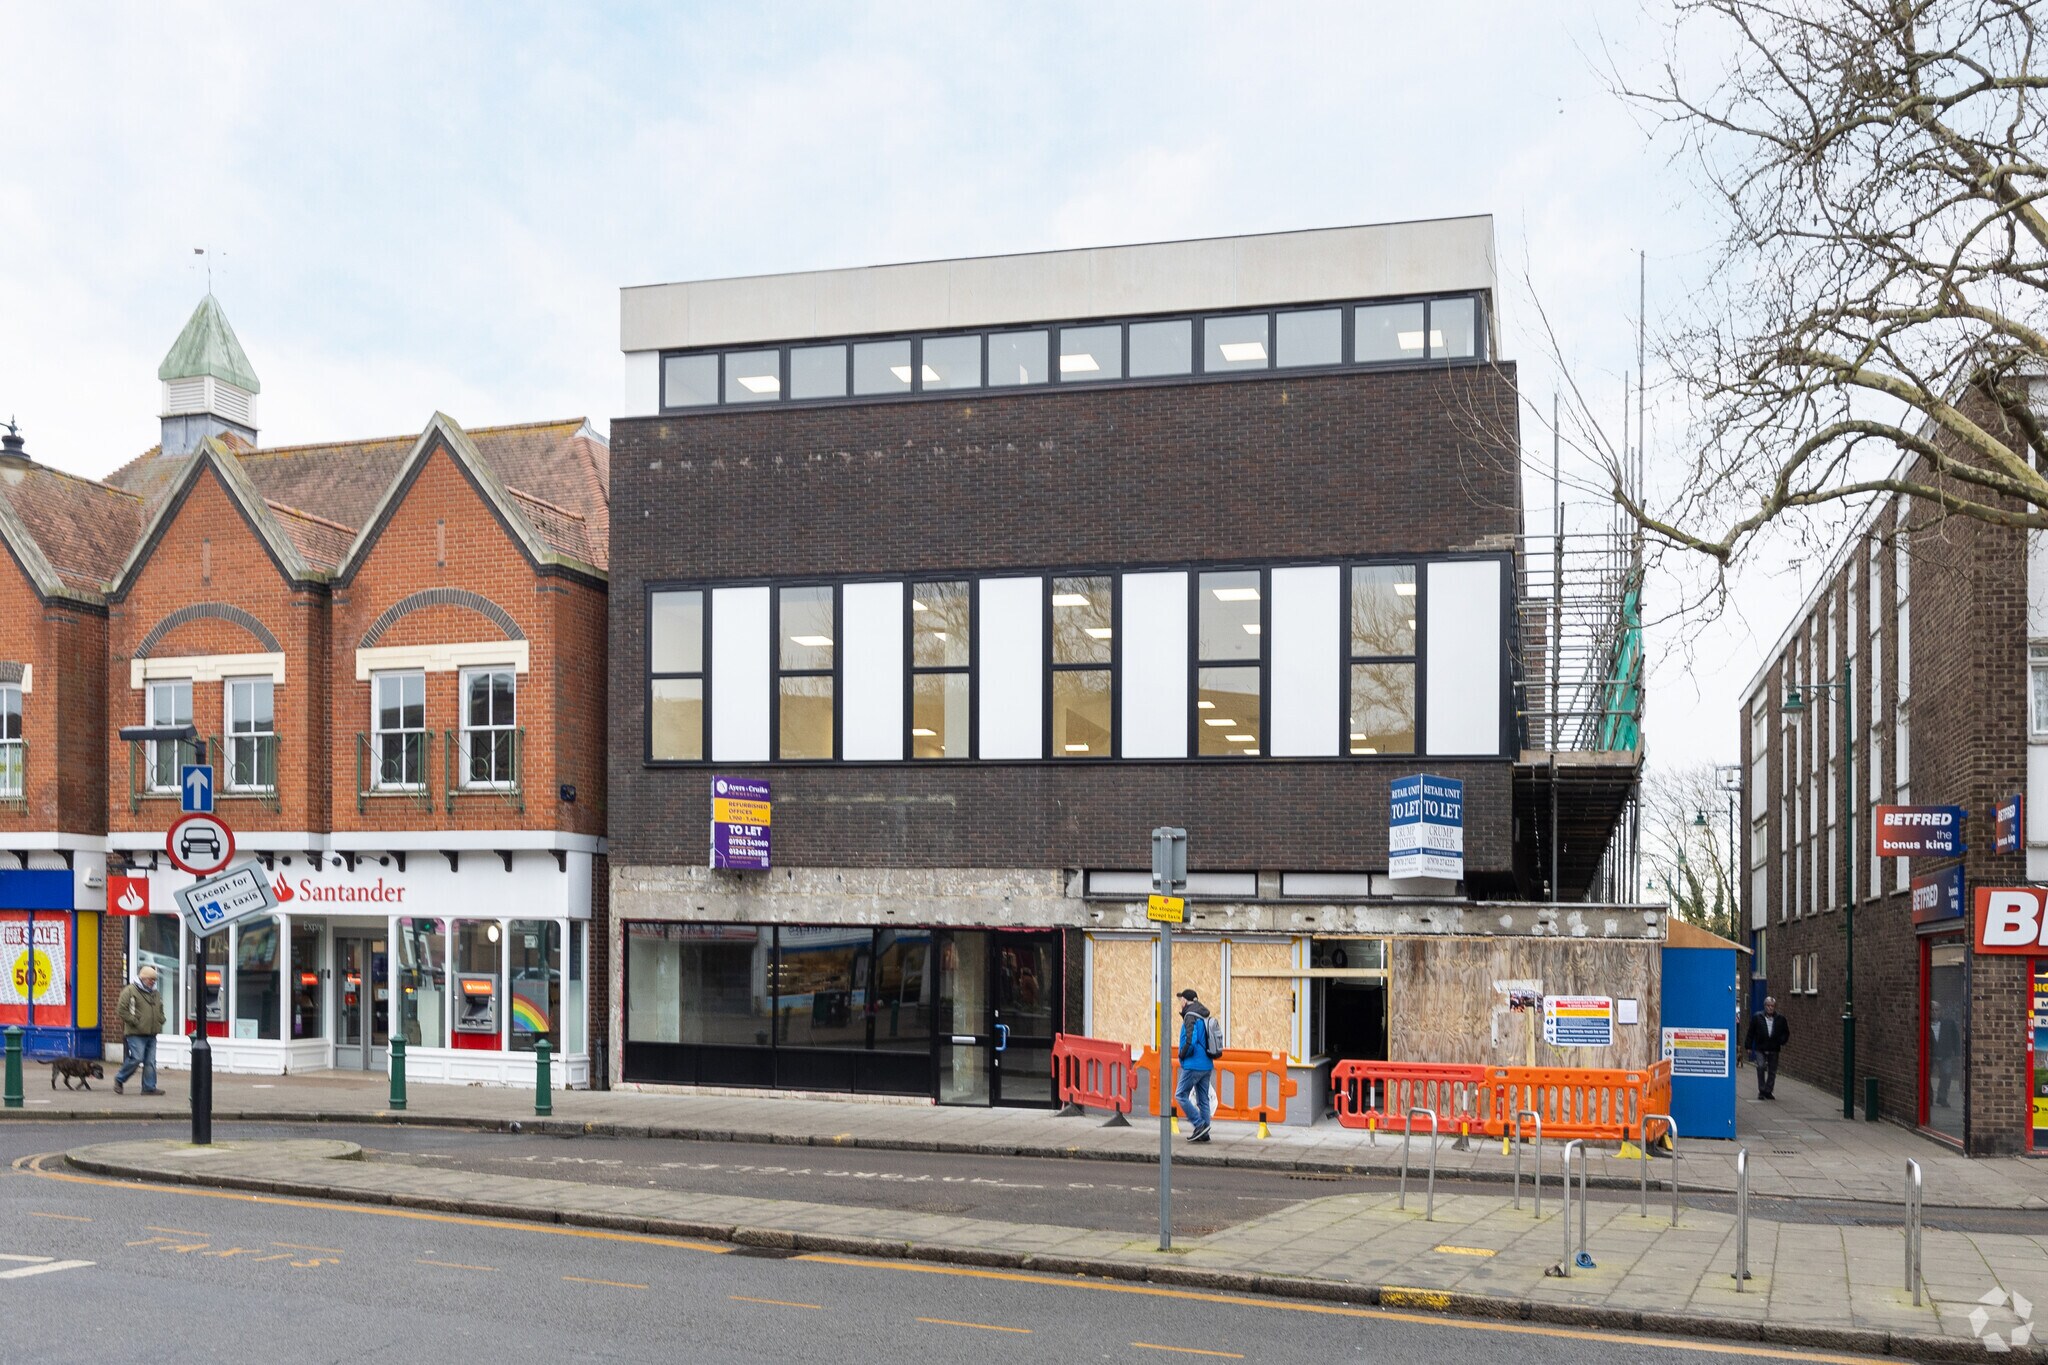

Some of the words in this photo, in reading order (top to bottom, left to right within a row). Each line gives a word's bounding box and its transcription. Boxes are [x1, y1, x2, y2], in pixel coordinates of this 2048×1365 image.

[729, 784, 745, 792] Ayers
[1391, 786, 1407, 799] RETAIL
[1408, 785, 1420, 796] UNIT
[1424, 785, 1444, 797] RETAIL
[1444, 787, 1460, 799] UNIT
[729, 801, 768, 809] REFURBISHED
[1391, 803, 1403, 819] TO
[1405, 800, 1420, 817] LET
[1424, 800, 1438, 816] TO
[1440, 802, 1460, 819] LET
[1884, 813, 1952, 826] BETFRED
[1998, 804, 2015, 822] BETFRED
[729, 825, 743, 835] TO
[745, 826, 762, 836] LET
[1429, 825, 1454, 838] CRUMP
[1936, 830, 1952, 840] the
[1427, 836, 1455, 849] WINTER
[1883, 840, 1921, 849] bonus
[1926, 840, 1952, 850] king
[194, 883, 230, 902] Except
[232, 877, 247, 888] for
[299, 878, 405, 902] Santander
[223, 902, 230, 911] &
[233, 892, 258, 907] taxis
[1913, 884, 1938, 911] BETFRED
[1159, 906, 1181, 914] stopping
[22, 926, 59, 945] SALE
[126, 1236, 340, 1268] TAXIS
